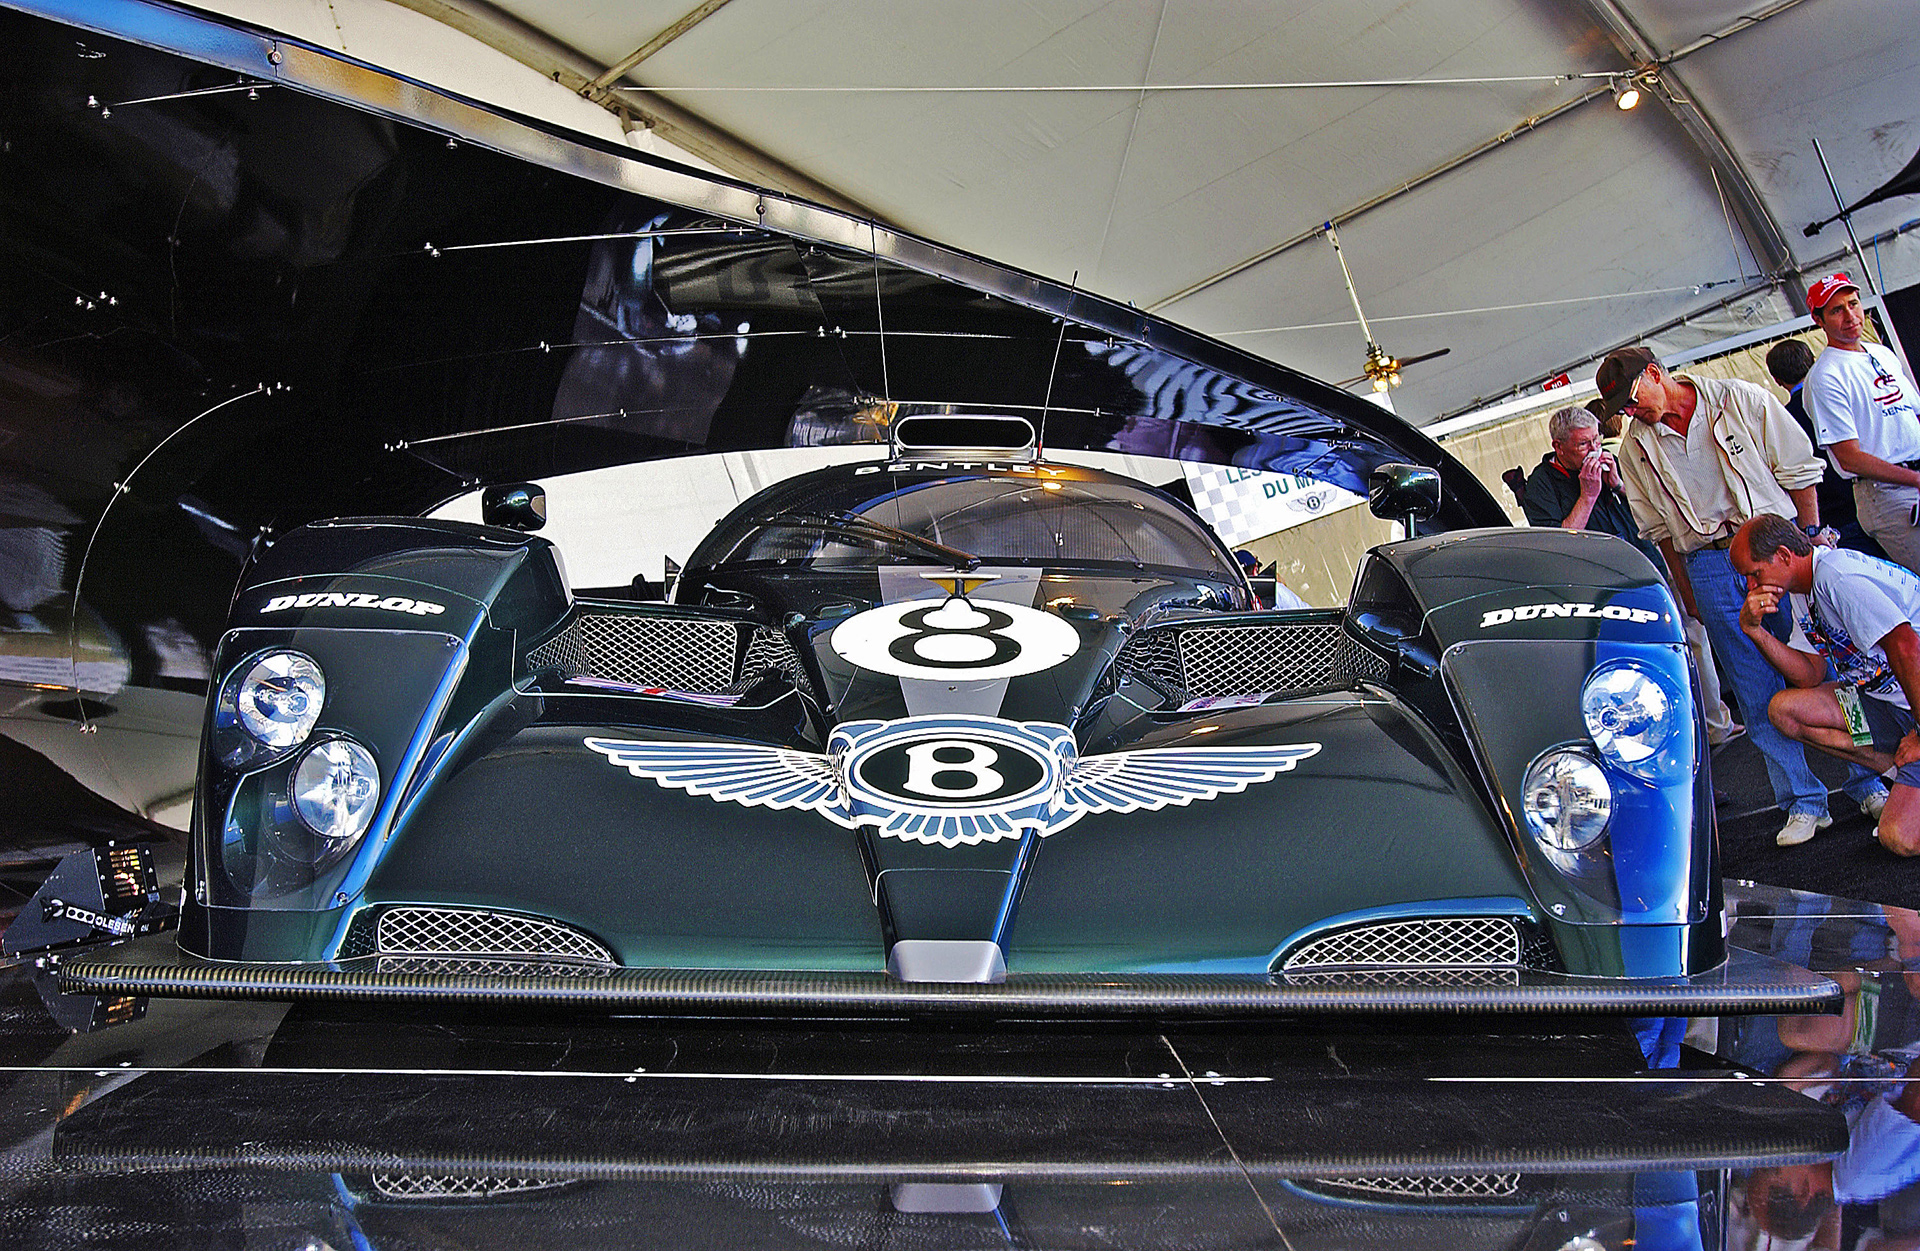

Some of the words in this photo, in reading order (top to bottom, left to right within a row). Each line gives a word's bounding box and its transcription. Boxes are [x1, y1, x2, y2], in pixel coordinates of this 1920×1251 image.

[855, 462, 1066, 477] BENTLEY
[1262, 478, 1290, 499] DU
[259, 592, 446, 615] DUNLOP
[1479, 603, 1660, 628] DUNLOP
[888, 605, 1022, 669] 8
[902, 739, 1006, 798] B
